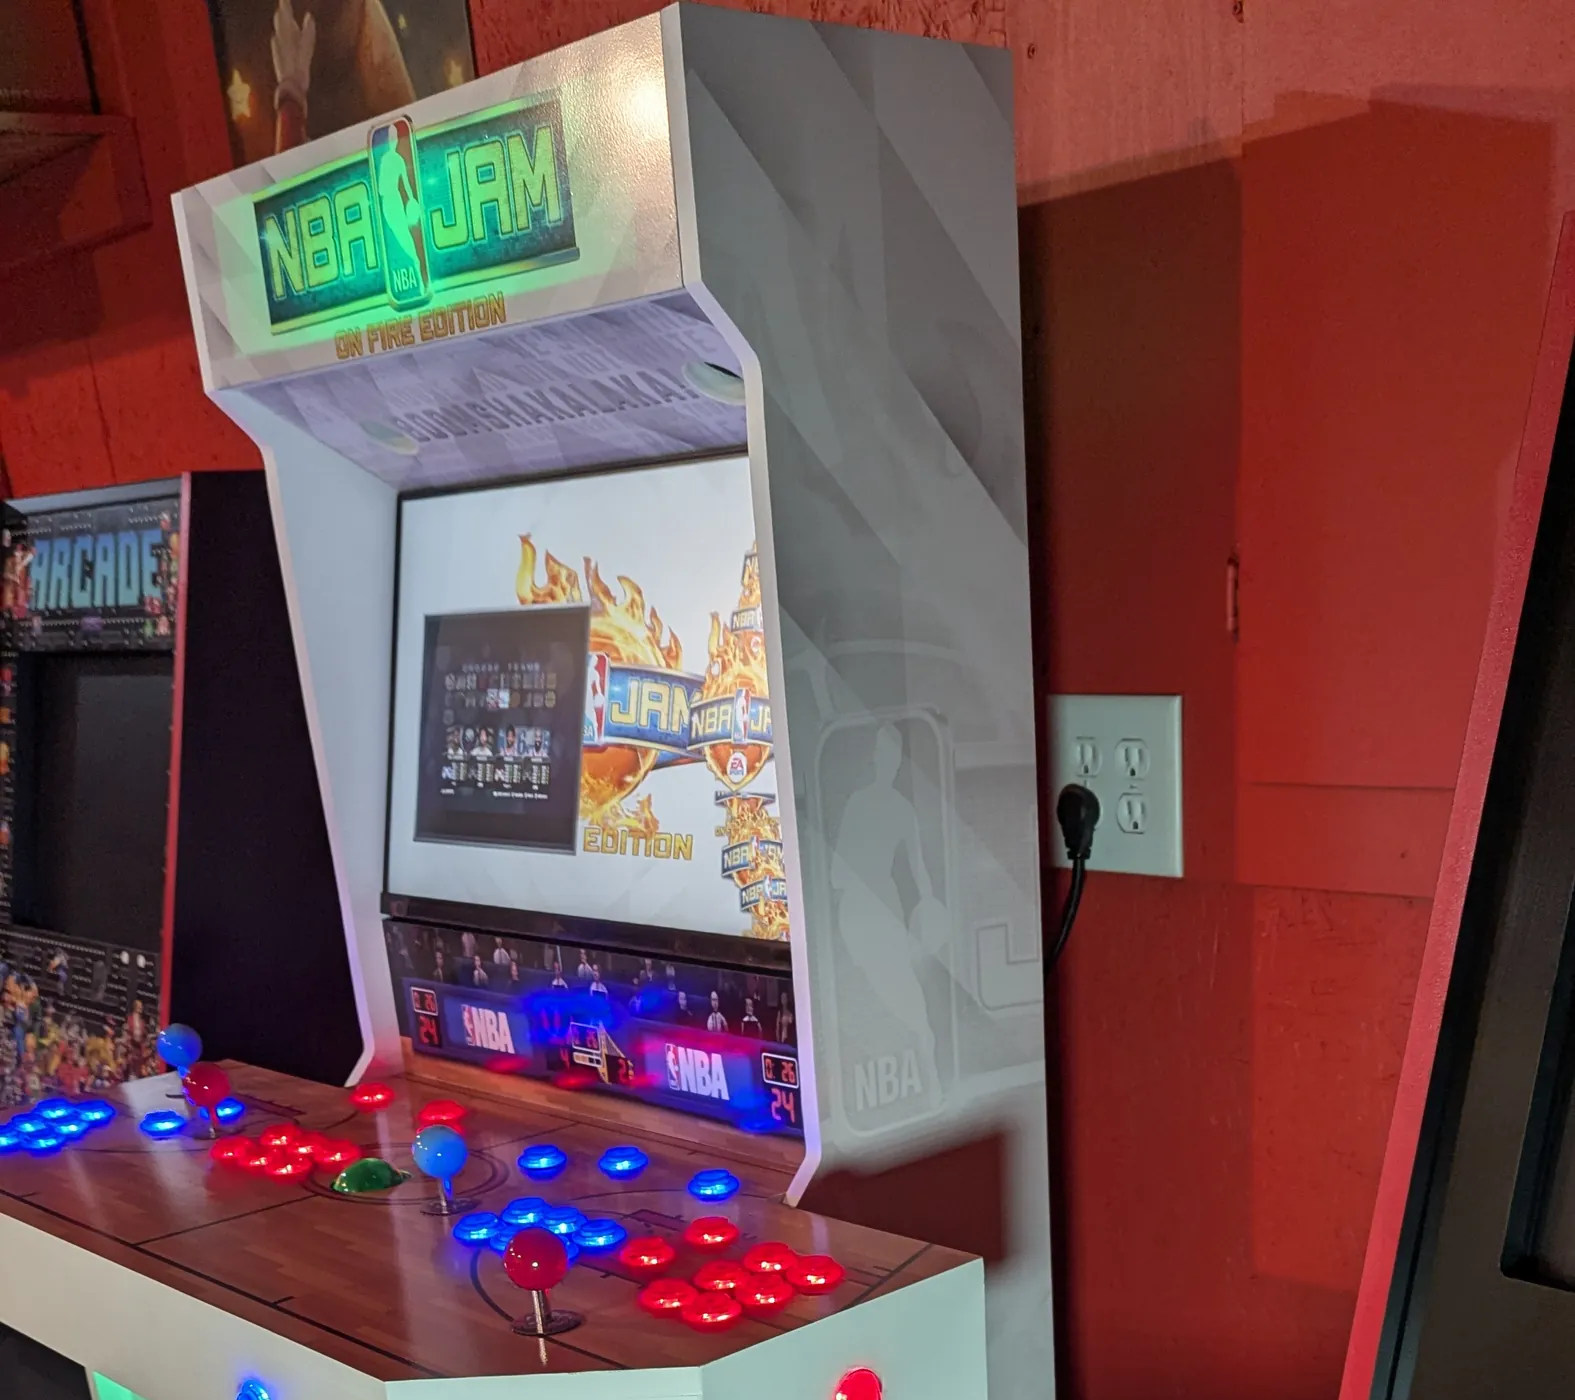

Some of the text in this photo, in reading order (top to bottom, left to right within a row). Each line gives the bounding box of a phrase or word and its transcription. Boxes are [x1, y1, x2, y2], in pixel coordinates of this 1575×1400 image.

[264, 125, 563, 301] NBA JAM
[392, 267, 417, 293] NBA
[335, 326, 363, 360] ON
[367, 313, 415, 352] FIRE
[418, 291, 507, 341] EDITION
[30, 528, 163, 610] ARCADE
[691, 703, 732, 739] NBA
[731, 757, 744, 769] EA
[584, 826, 694, 861] EDITION
[471, 1005, 516, 1055] NBA
[677, 1046, 730, 1101] NBA
[781, 1061, 796, 1084] 26
[853, 1048, 922, 1112] NBA
[771, 1088, 795, 1123] 24
